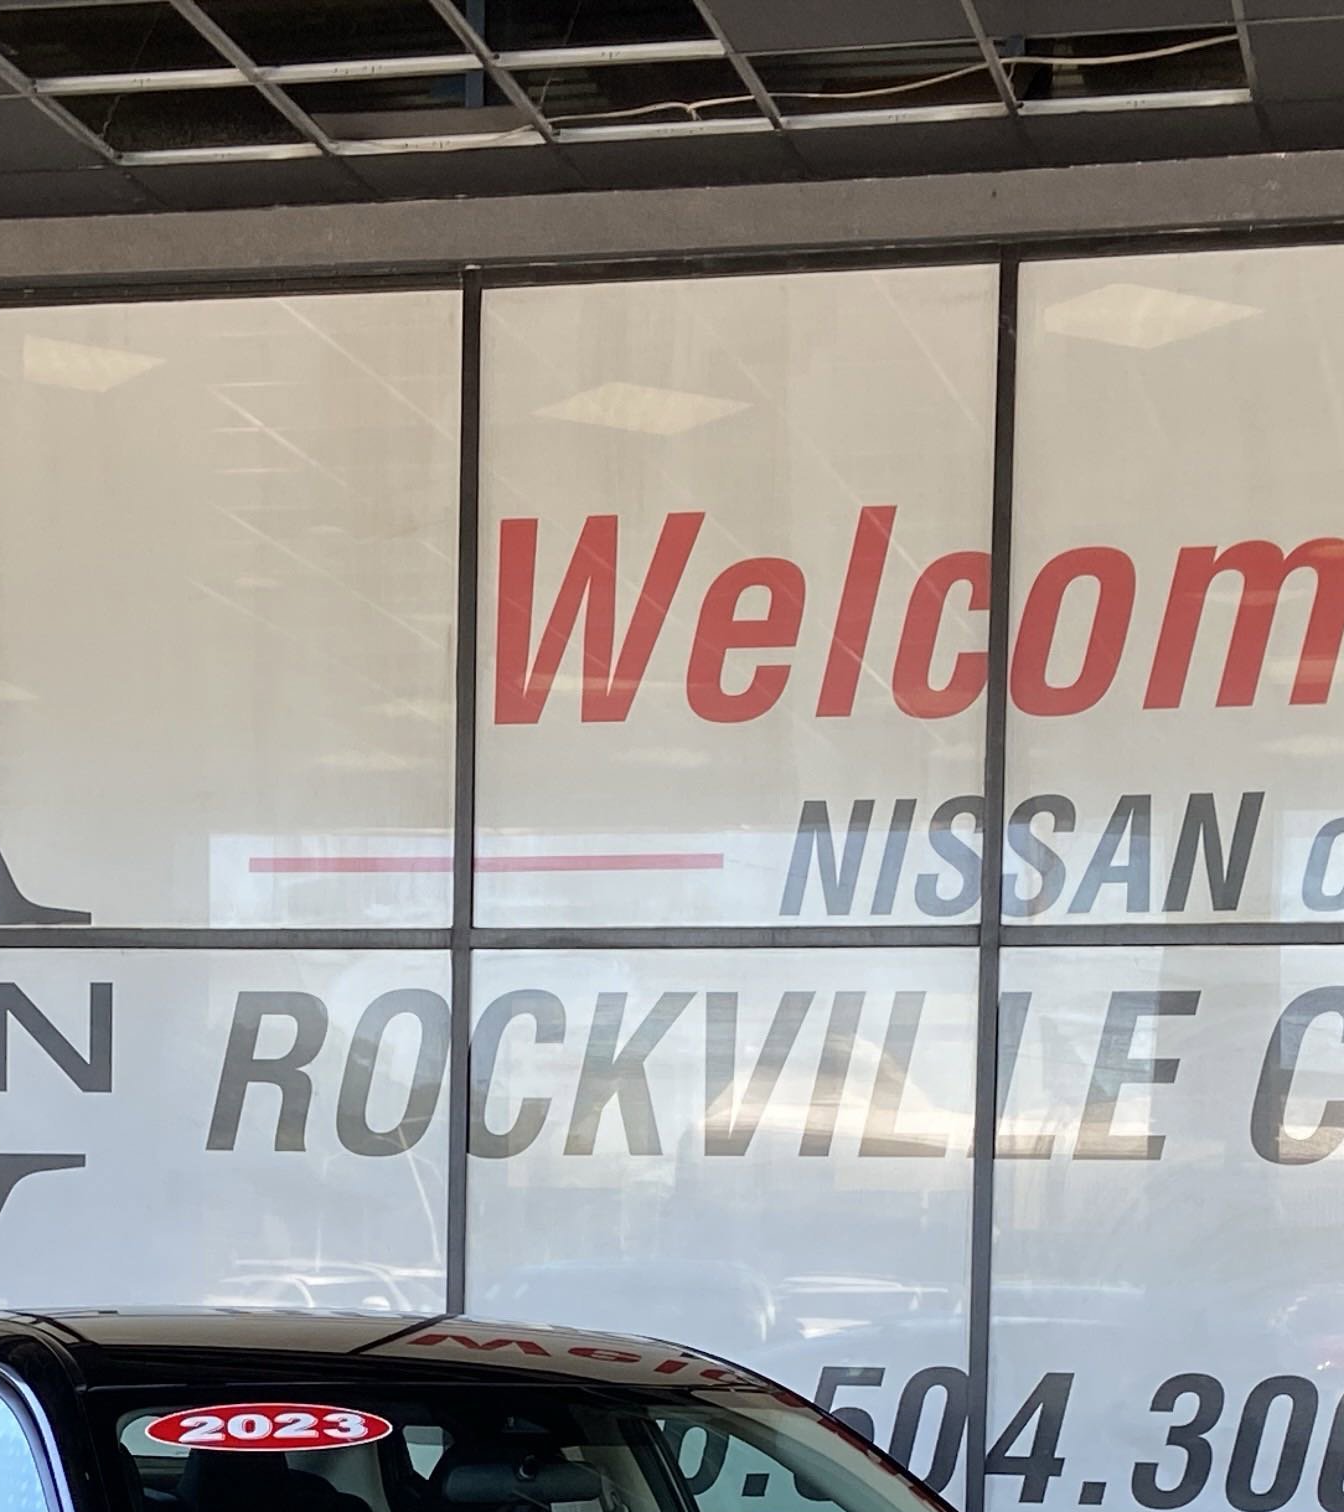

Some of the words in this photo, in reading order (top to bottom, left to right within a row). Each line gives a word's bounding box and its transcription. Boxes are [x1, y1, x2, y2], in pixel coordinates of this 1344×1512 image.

[778, 790, 1264, 917] NISSAN
[206, 987, 1202, 1161] ROCKVILLE
[177, 1412, 369, 1443] 2023
